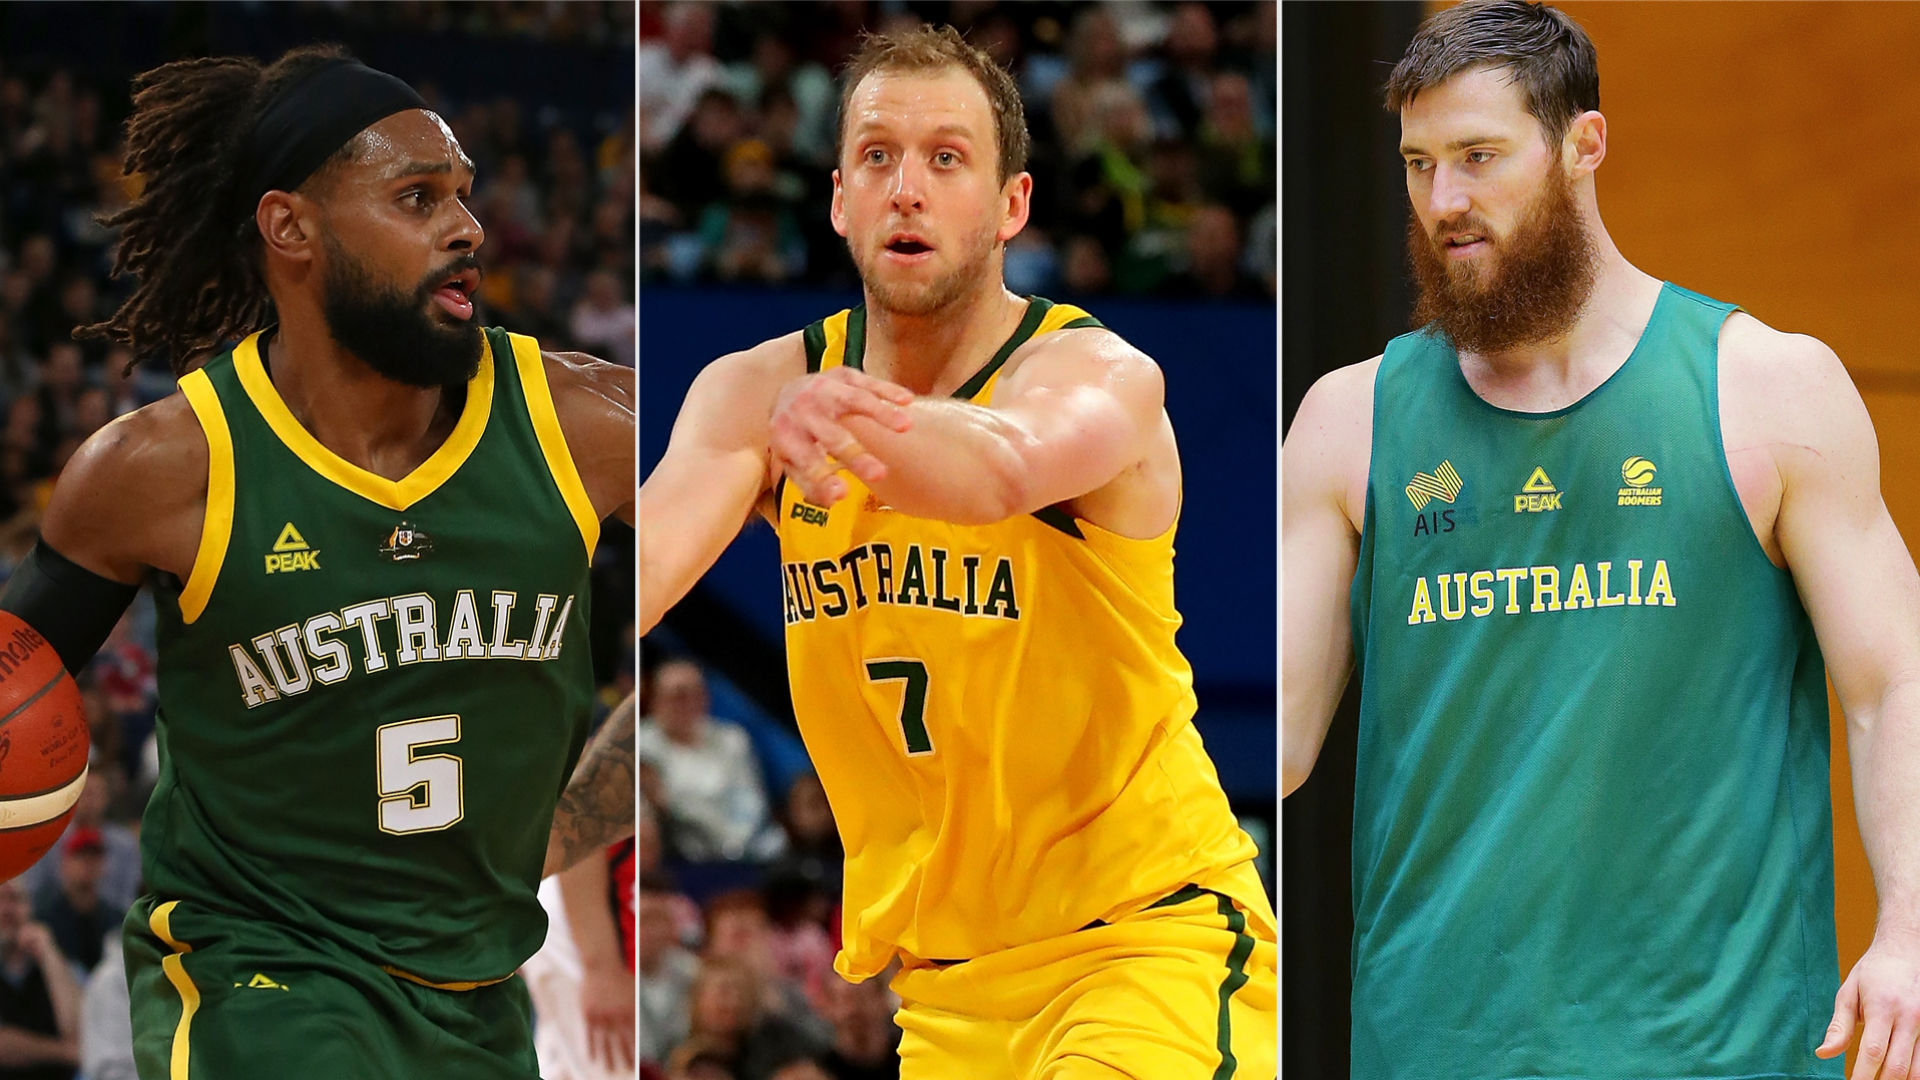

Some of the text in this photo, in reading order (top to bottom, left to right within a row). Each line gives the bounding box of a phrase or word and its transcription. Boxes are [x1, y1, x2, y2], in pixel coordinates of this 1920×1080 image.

[1413, 509, 1456, 537] AIS
[1513, 491, 1564, 513] PEAK
[1617, 496, 1662, 506] BOOMERS
[264, 550, 321, 575] PEAK
[783, 542, 1021, 626] AUSTRALIA
[1407, 559, 1677, 626] AUSTRALIA
[228, 589, 575, 709] AUSTRALIA
[863, 656, 936, 757] 7
[376, 714, 465, 836] 5
